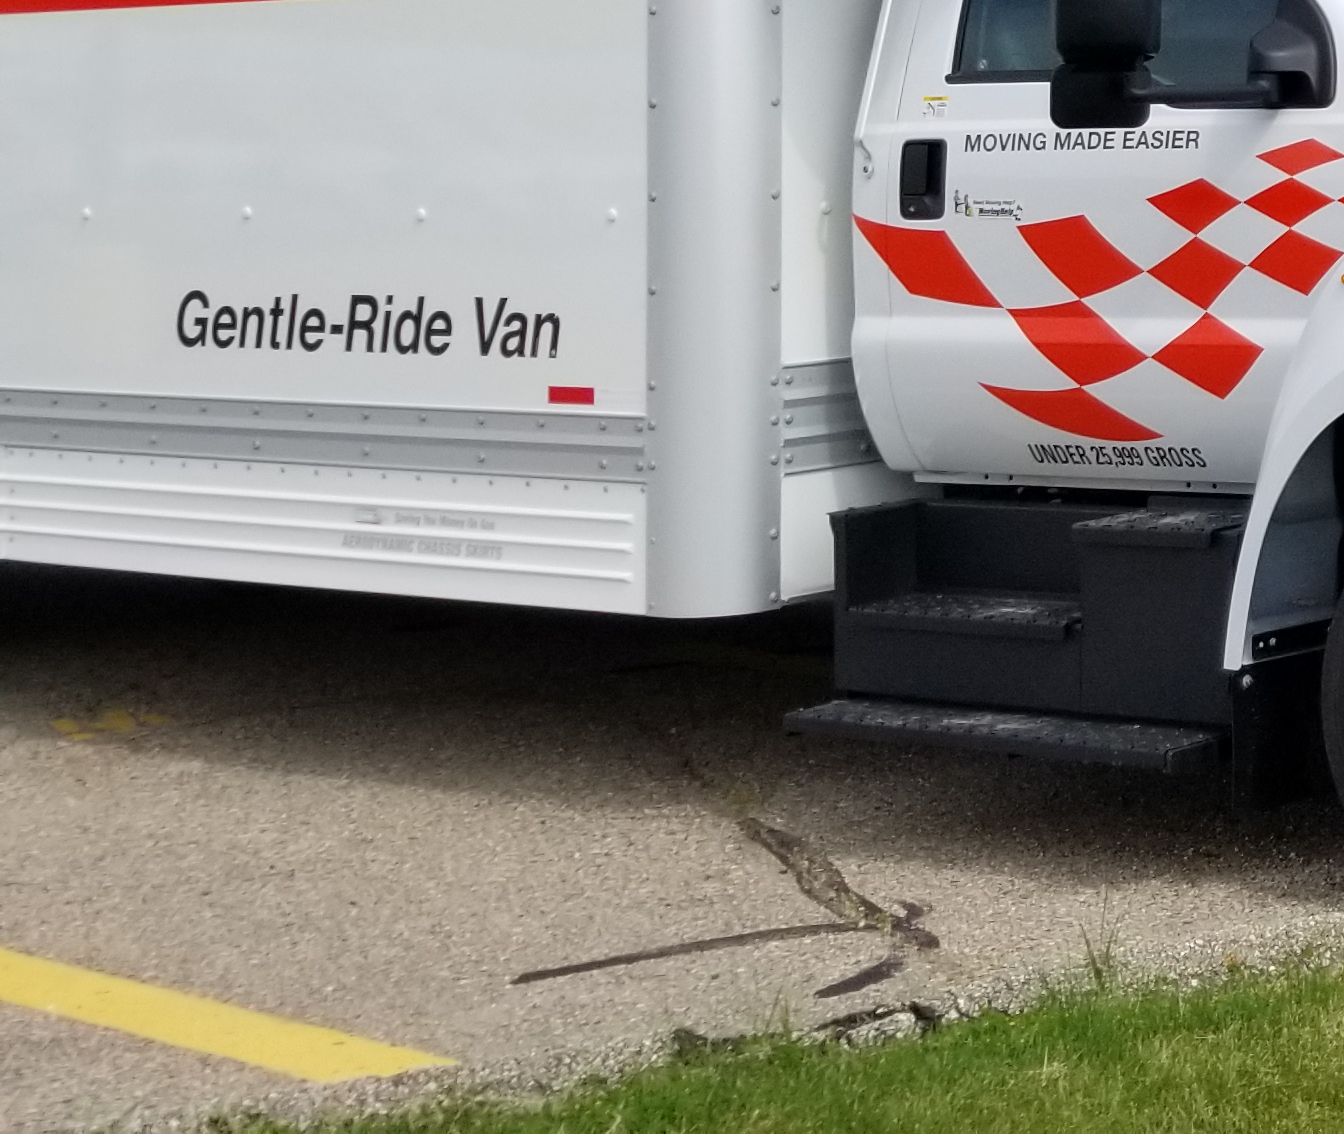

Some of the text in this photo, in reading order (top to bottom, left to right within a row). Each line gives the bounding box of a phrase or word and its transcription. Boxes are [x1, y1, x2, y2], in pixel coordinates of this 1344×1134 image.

[964, 129, 1201, 154] MOVING MADE EASIER
[176, 289, 561, 359] Gentle-Ride Van
[1027, 444, 1208, 470] UNDER 25,999 GROSS
